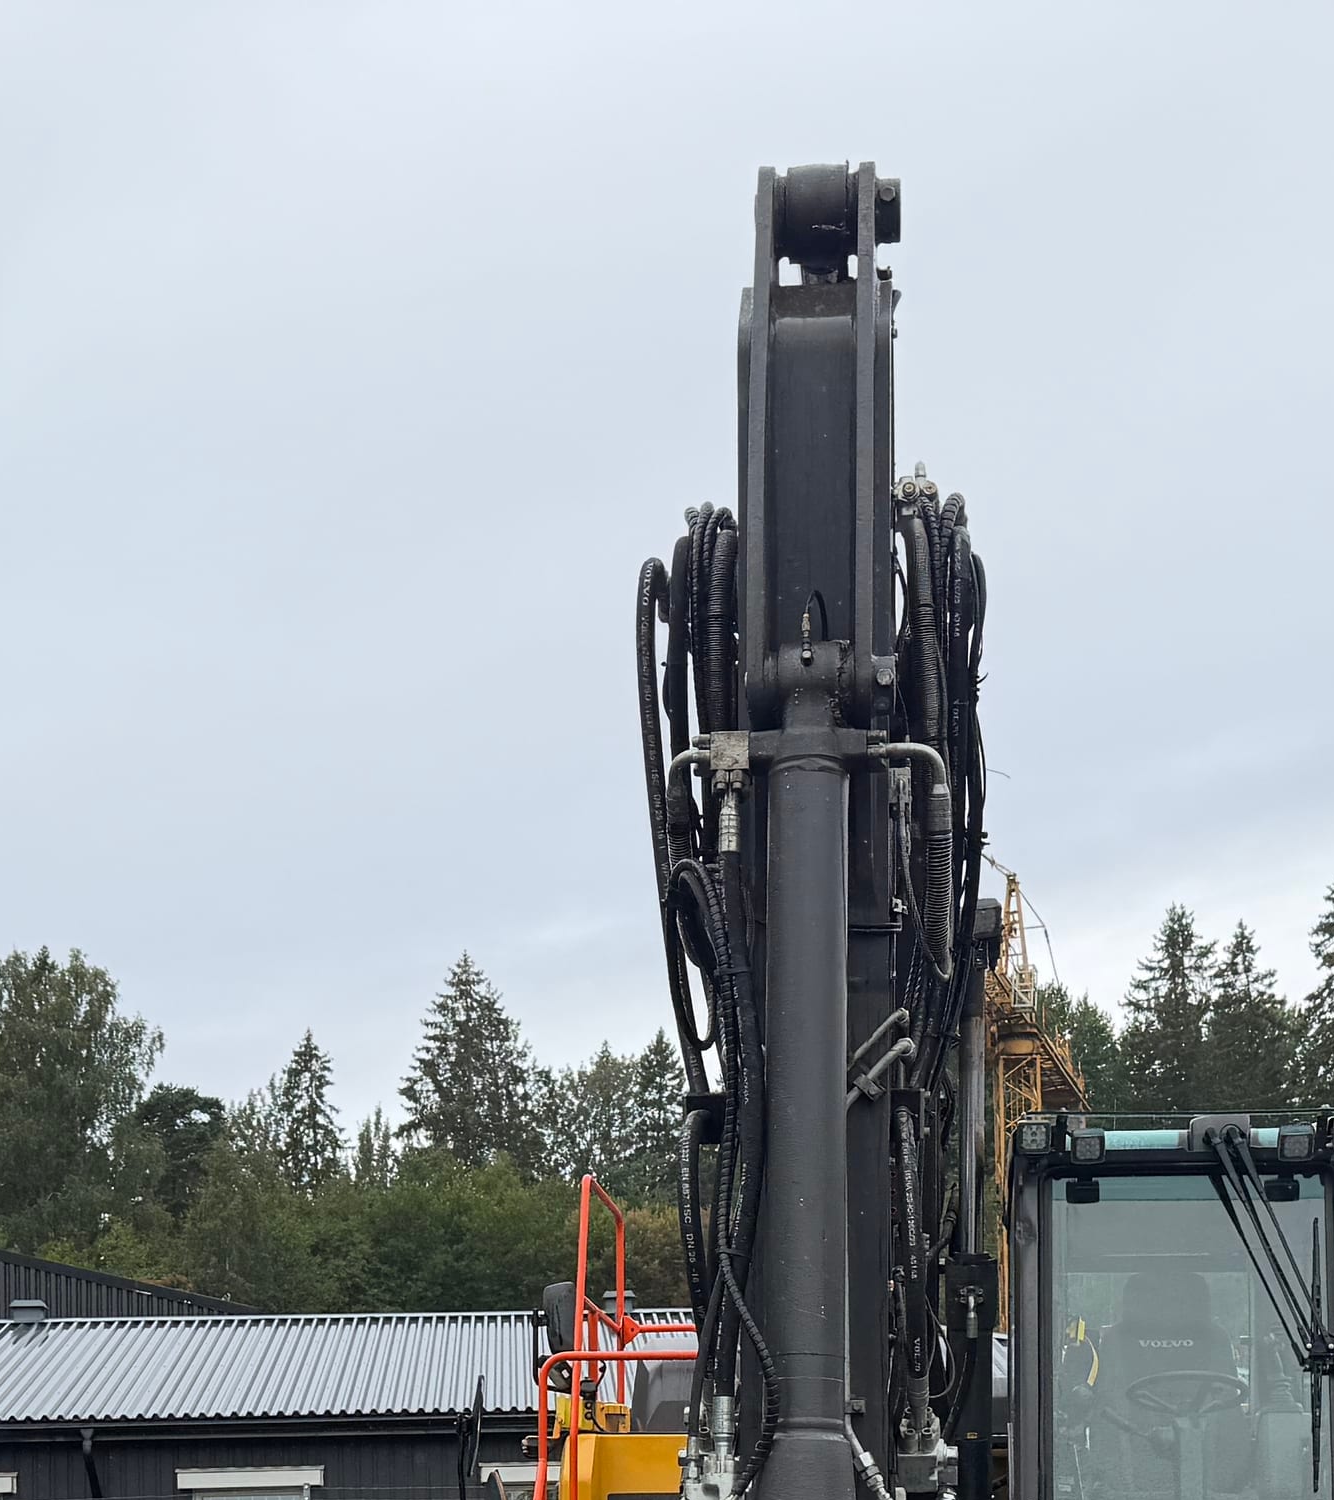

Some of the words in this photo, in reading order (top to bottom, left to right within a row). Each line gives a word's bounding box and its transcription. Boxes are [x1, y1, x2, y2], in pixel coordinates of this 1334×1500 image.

[684, 1203, 692, 1224] 1SC
[686, 1233, 695, 1249] DN
[1138, 1339, 1194, 1348] VOLVO
